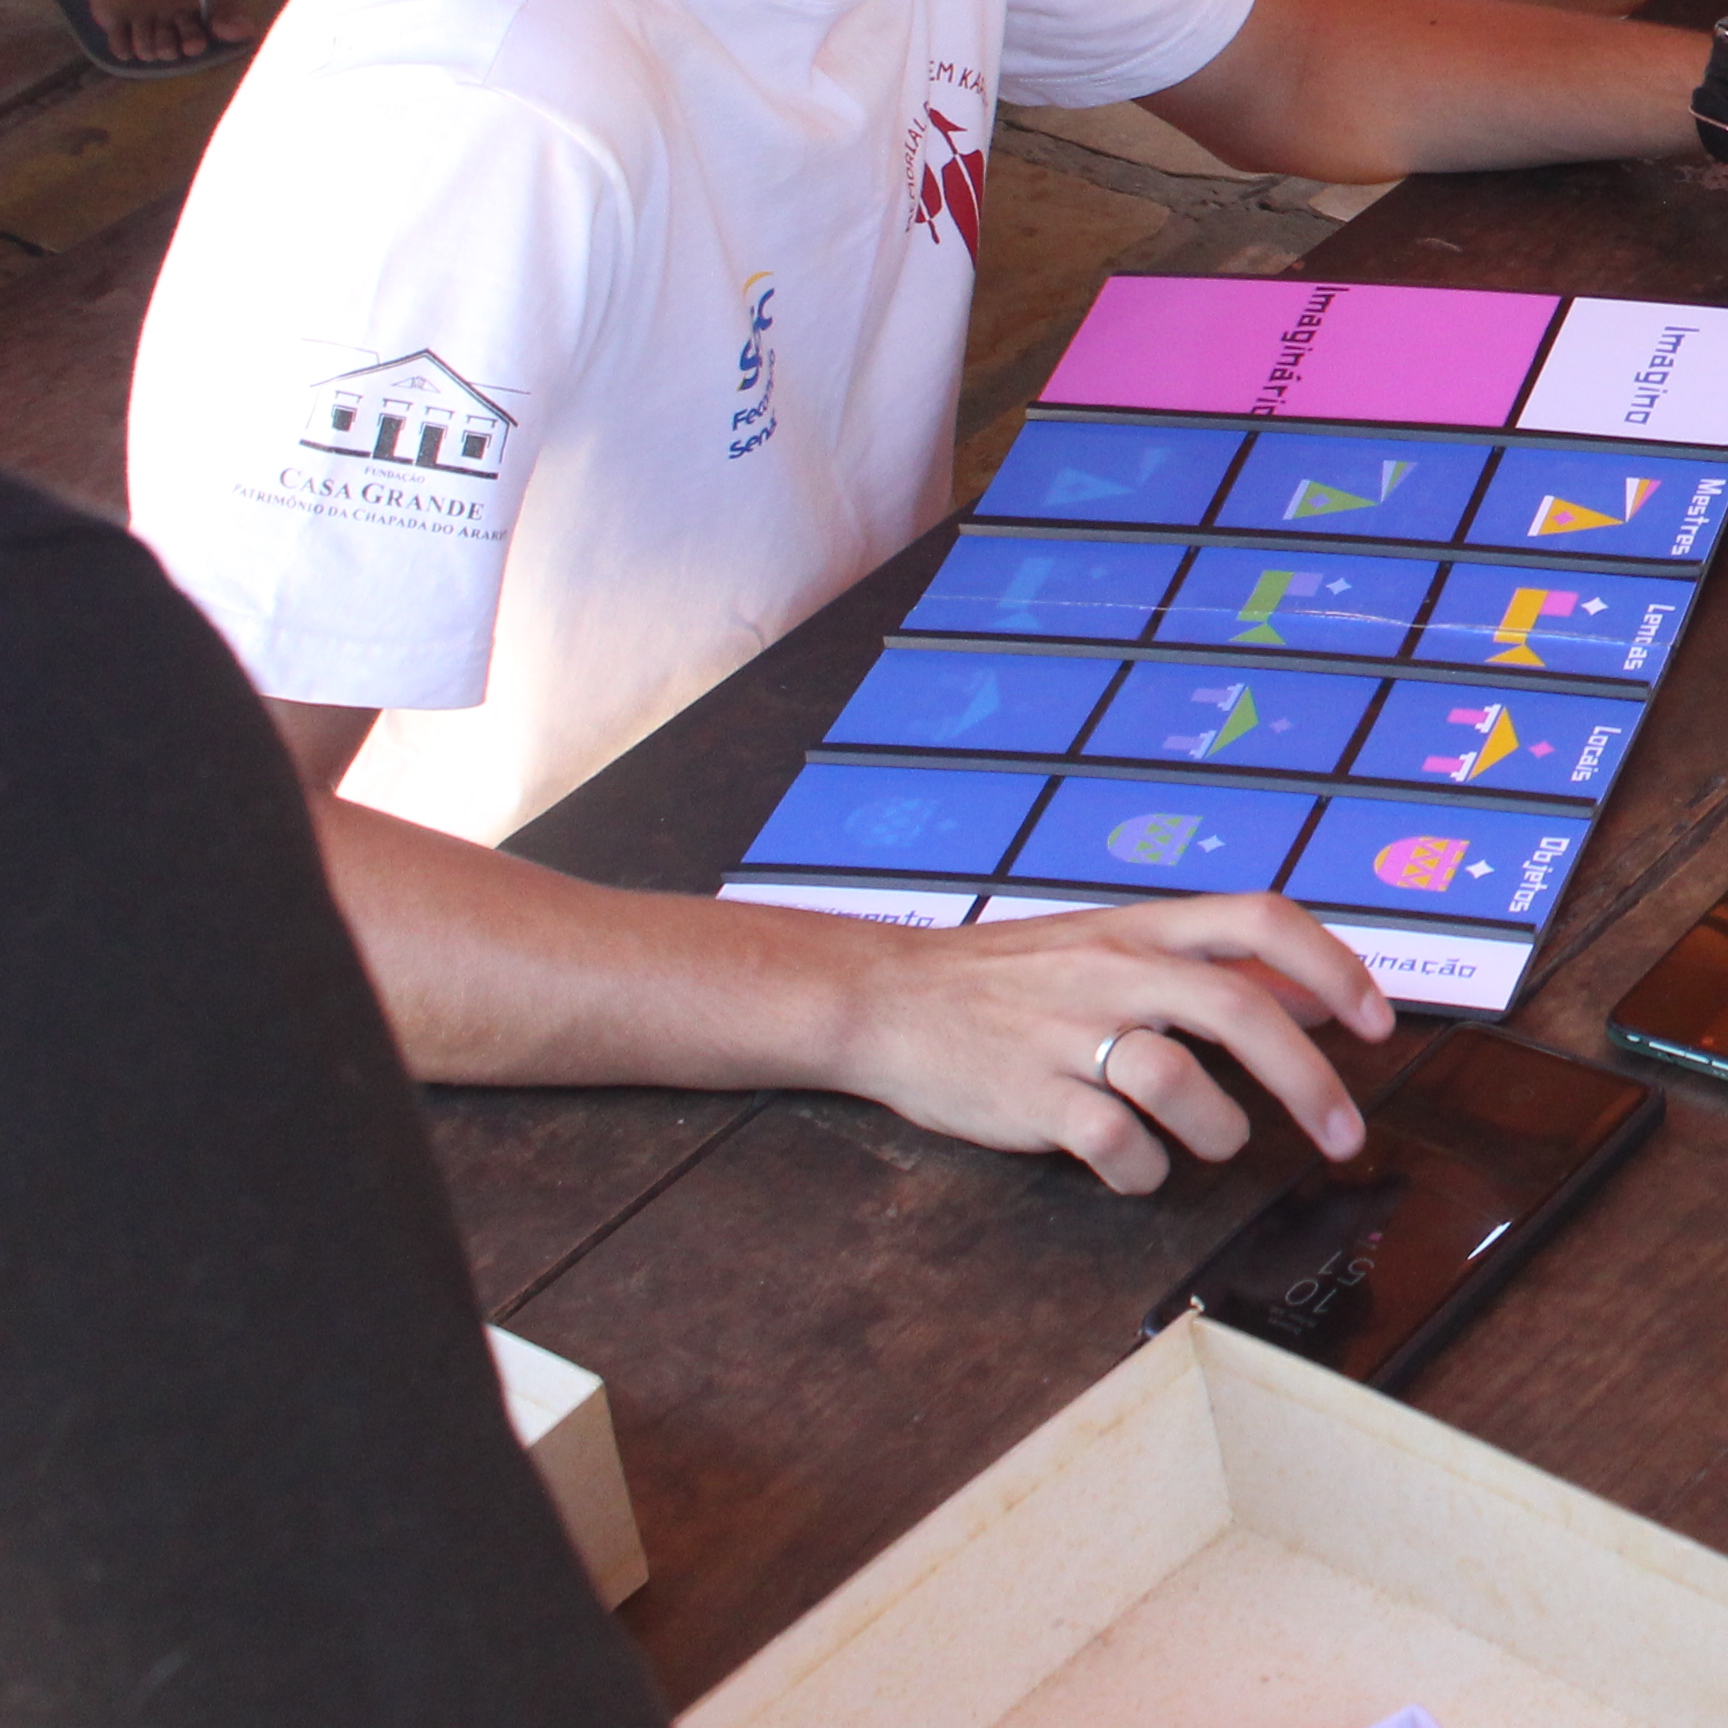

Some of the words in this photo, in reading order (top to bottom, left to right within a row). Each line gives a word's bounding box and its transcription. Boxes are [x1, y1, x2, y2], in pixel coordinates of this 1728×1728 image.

[1623, 325, 1701, 425] Imagino
[279, 467, 353, 501] CASA
[361, 481, 486, 522] GRANDE
[364, 465, 427, 485] FUNDAÇÃO
[232, 482, 326, 516] PATRIMÔNIO
[327, 506, 349, 520] DA
[352, 507, 428, 533] CHAPADA
[432, 523, 454, 536] DO
[1671, 477, 1727, 557] Mestres
[1570, 725, 1623, 783] Locais
[1507, 836, 1571, 913] Objetos
